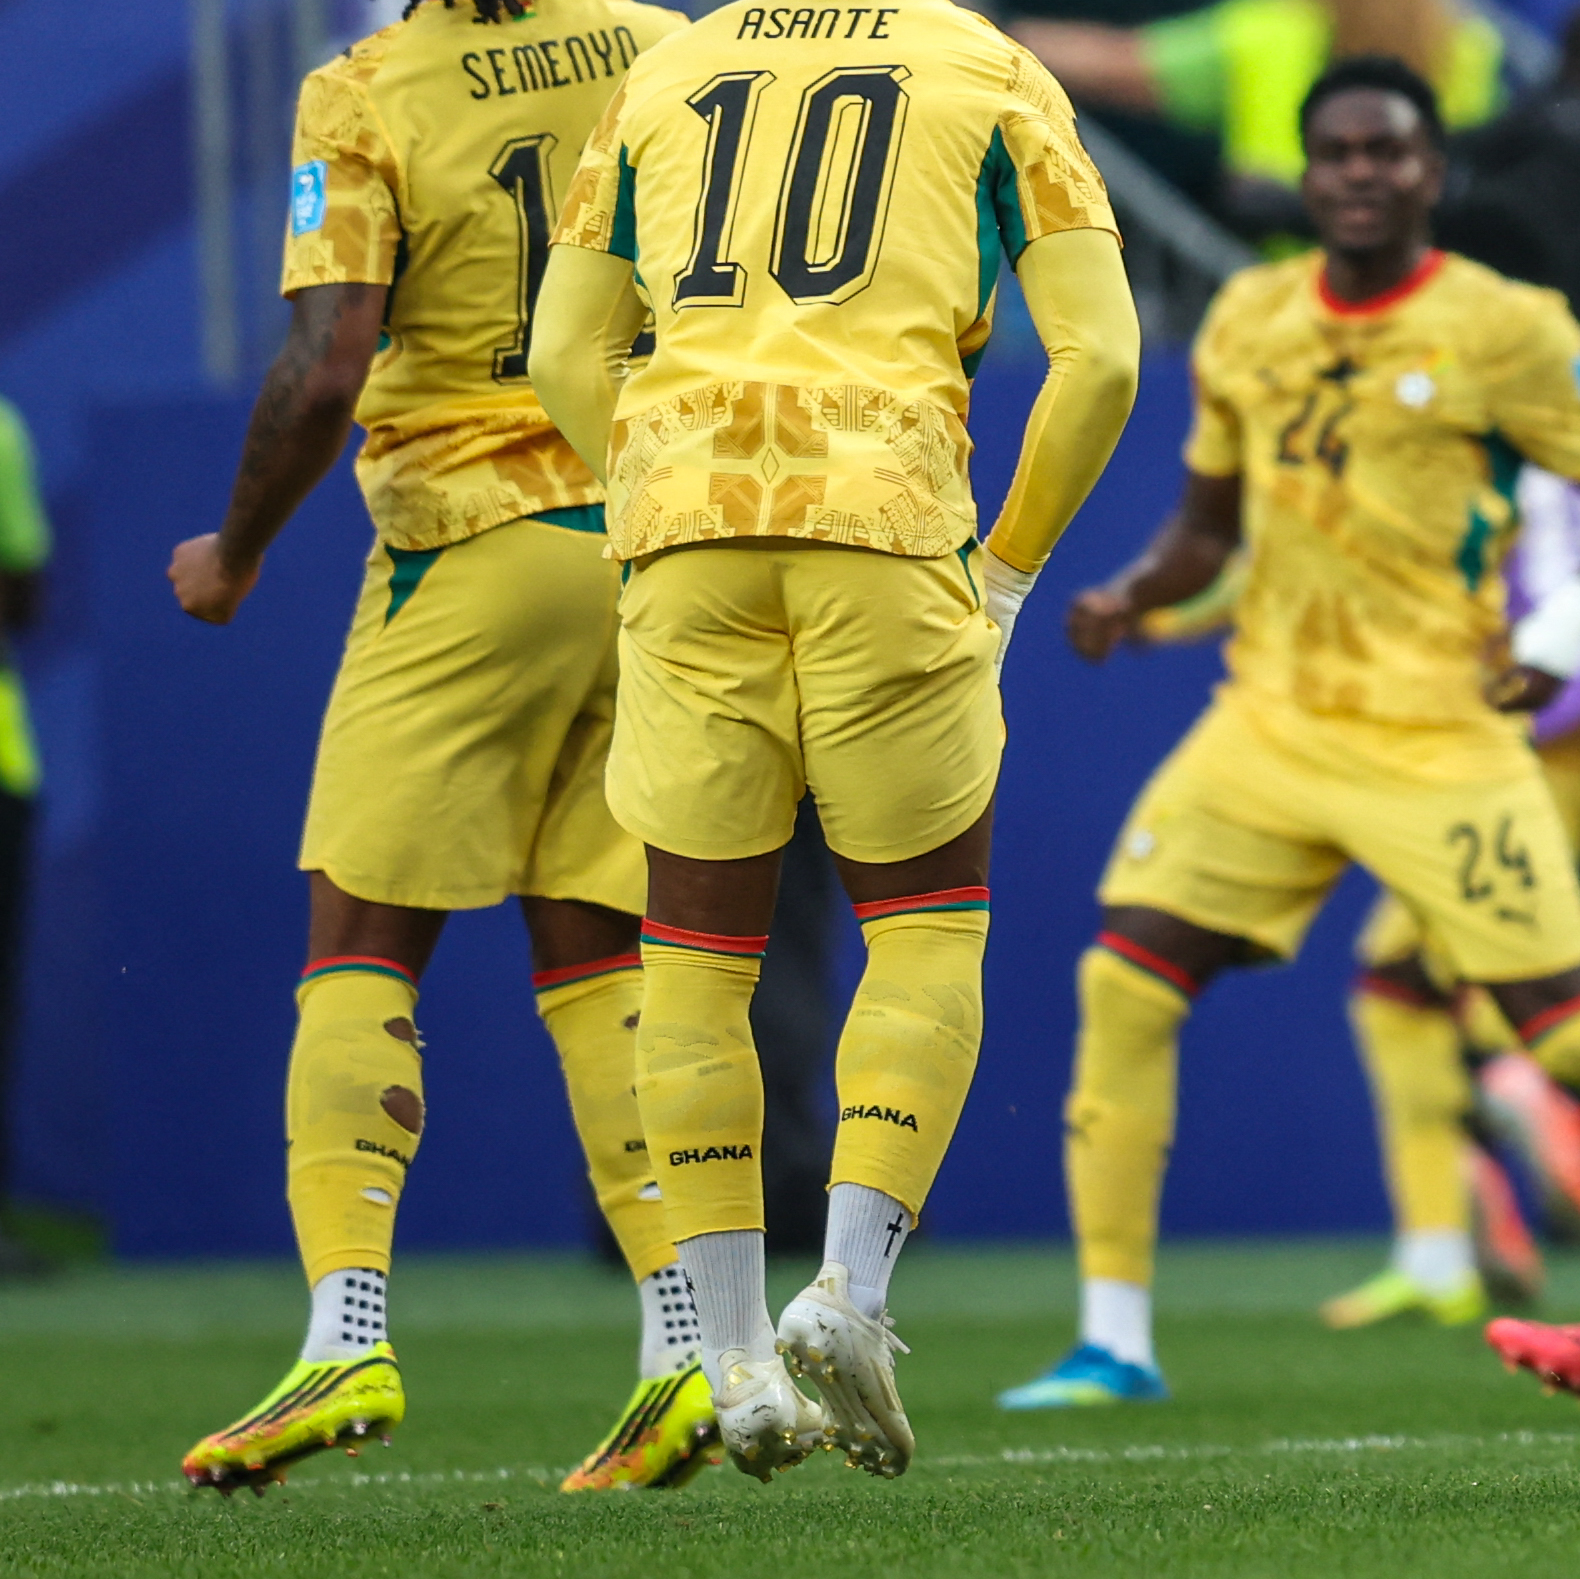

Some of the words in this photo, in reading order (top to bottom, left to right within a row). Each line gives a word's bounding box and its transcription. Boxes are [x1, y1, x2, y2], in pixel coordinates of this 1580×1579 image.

[736, 7, 901, 40] ASANTE
[672, 65, 912, 312] 10
[1446, 809, 1536, 902] 24
[841, 1105, 918, 1133] GHANA
[669, 1144, 753, 1166] GHANA
